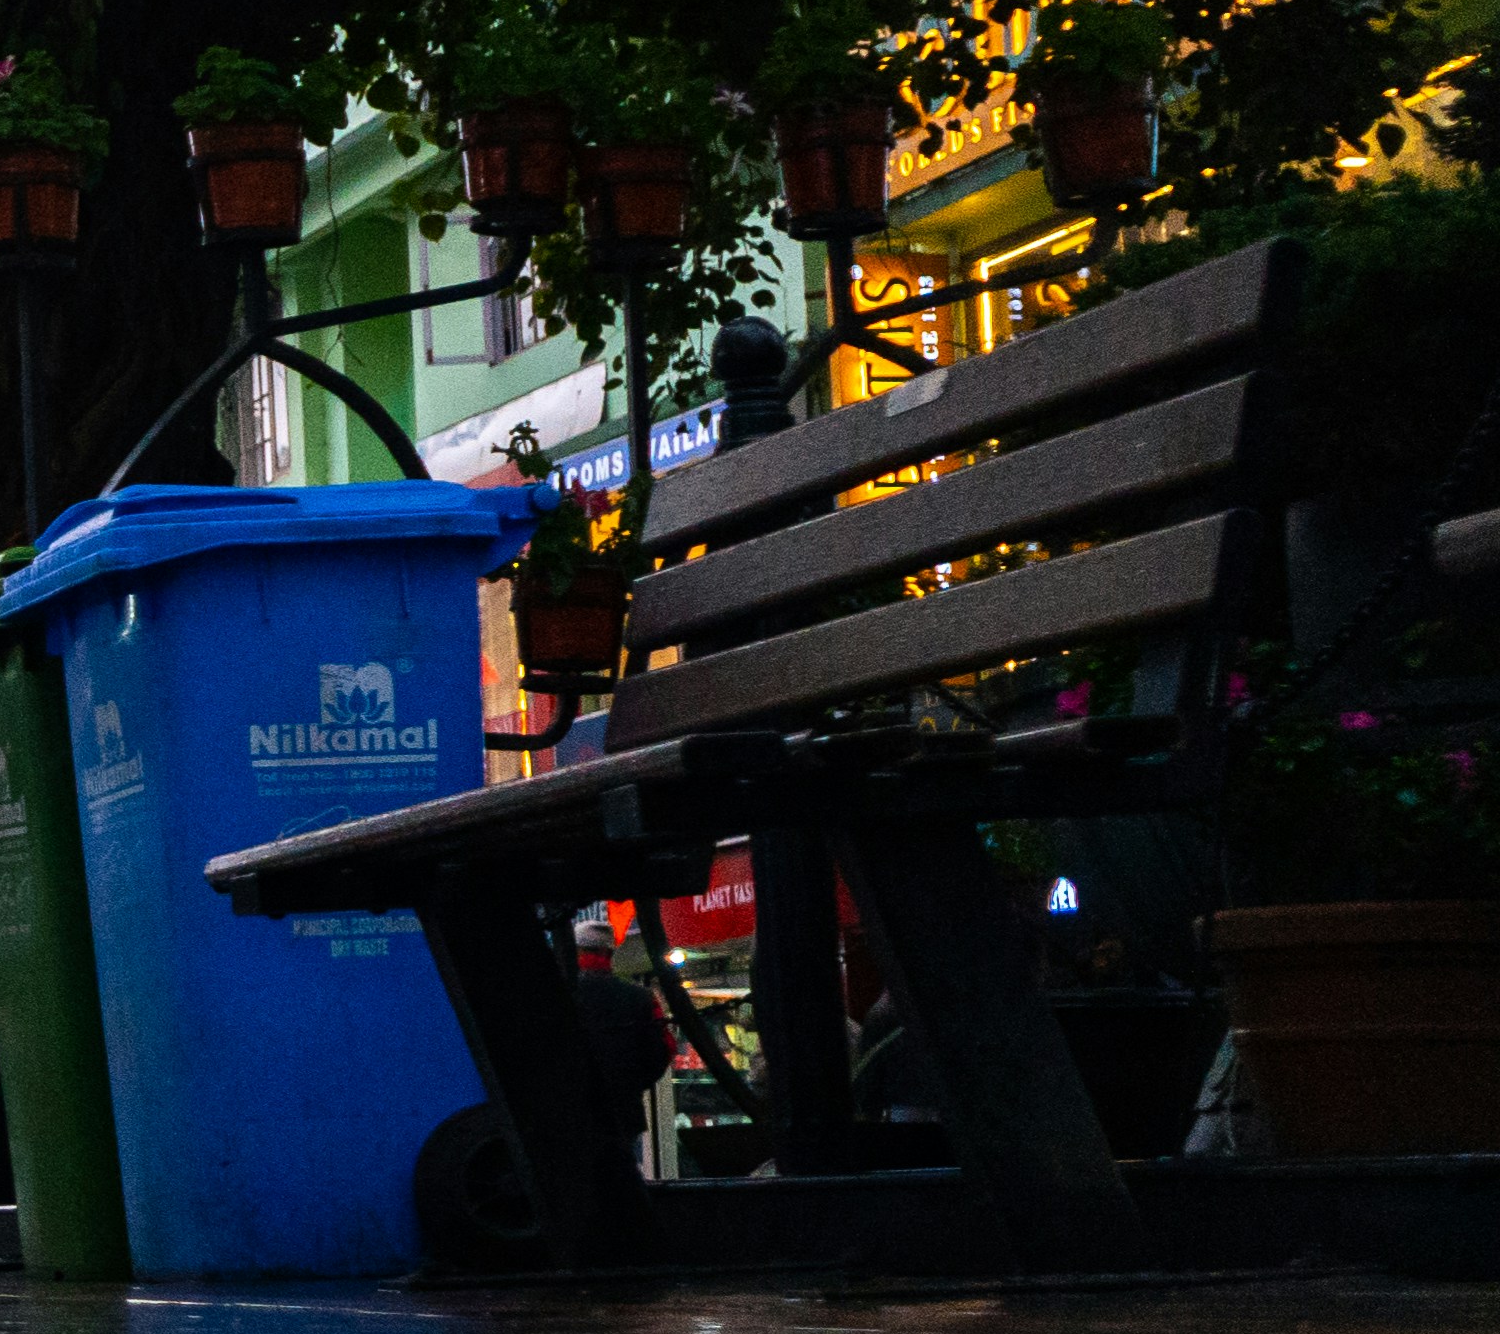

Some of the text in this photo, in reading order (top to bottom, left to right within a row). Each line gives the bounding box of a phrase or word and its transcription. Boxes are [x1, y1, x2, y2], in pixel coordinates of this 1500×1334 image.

[553, 450, 625, 491] OOMS
[249, 718, 438, 756] Nilkamal
[693, 884, 731, 913] PLANET
